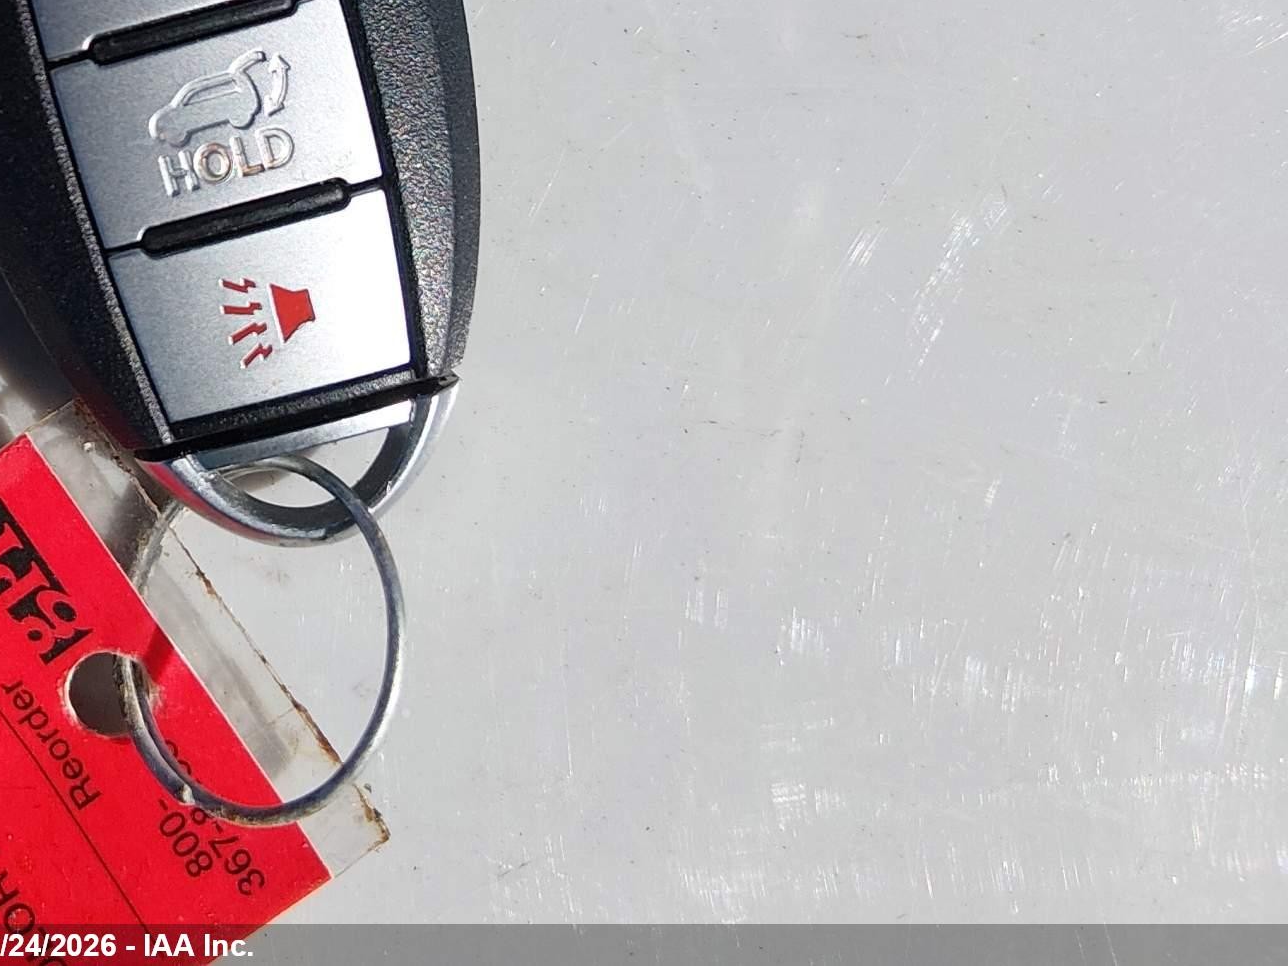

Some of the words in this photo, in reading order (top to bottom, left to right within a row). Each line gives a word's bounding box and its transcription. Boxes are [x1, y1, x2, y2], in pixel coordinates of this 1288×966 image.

[158, 127, 295, 197] HOLD
[0, 680, 103, 811] Reorder
[158, 797, 214, 878] 800-
